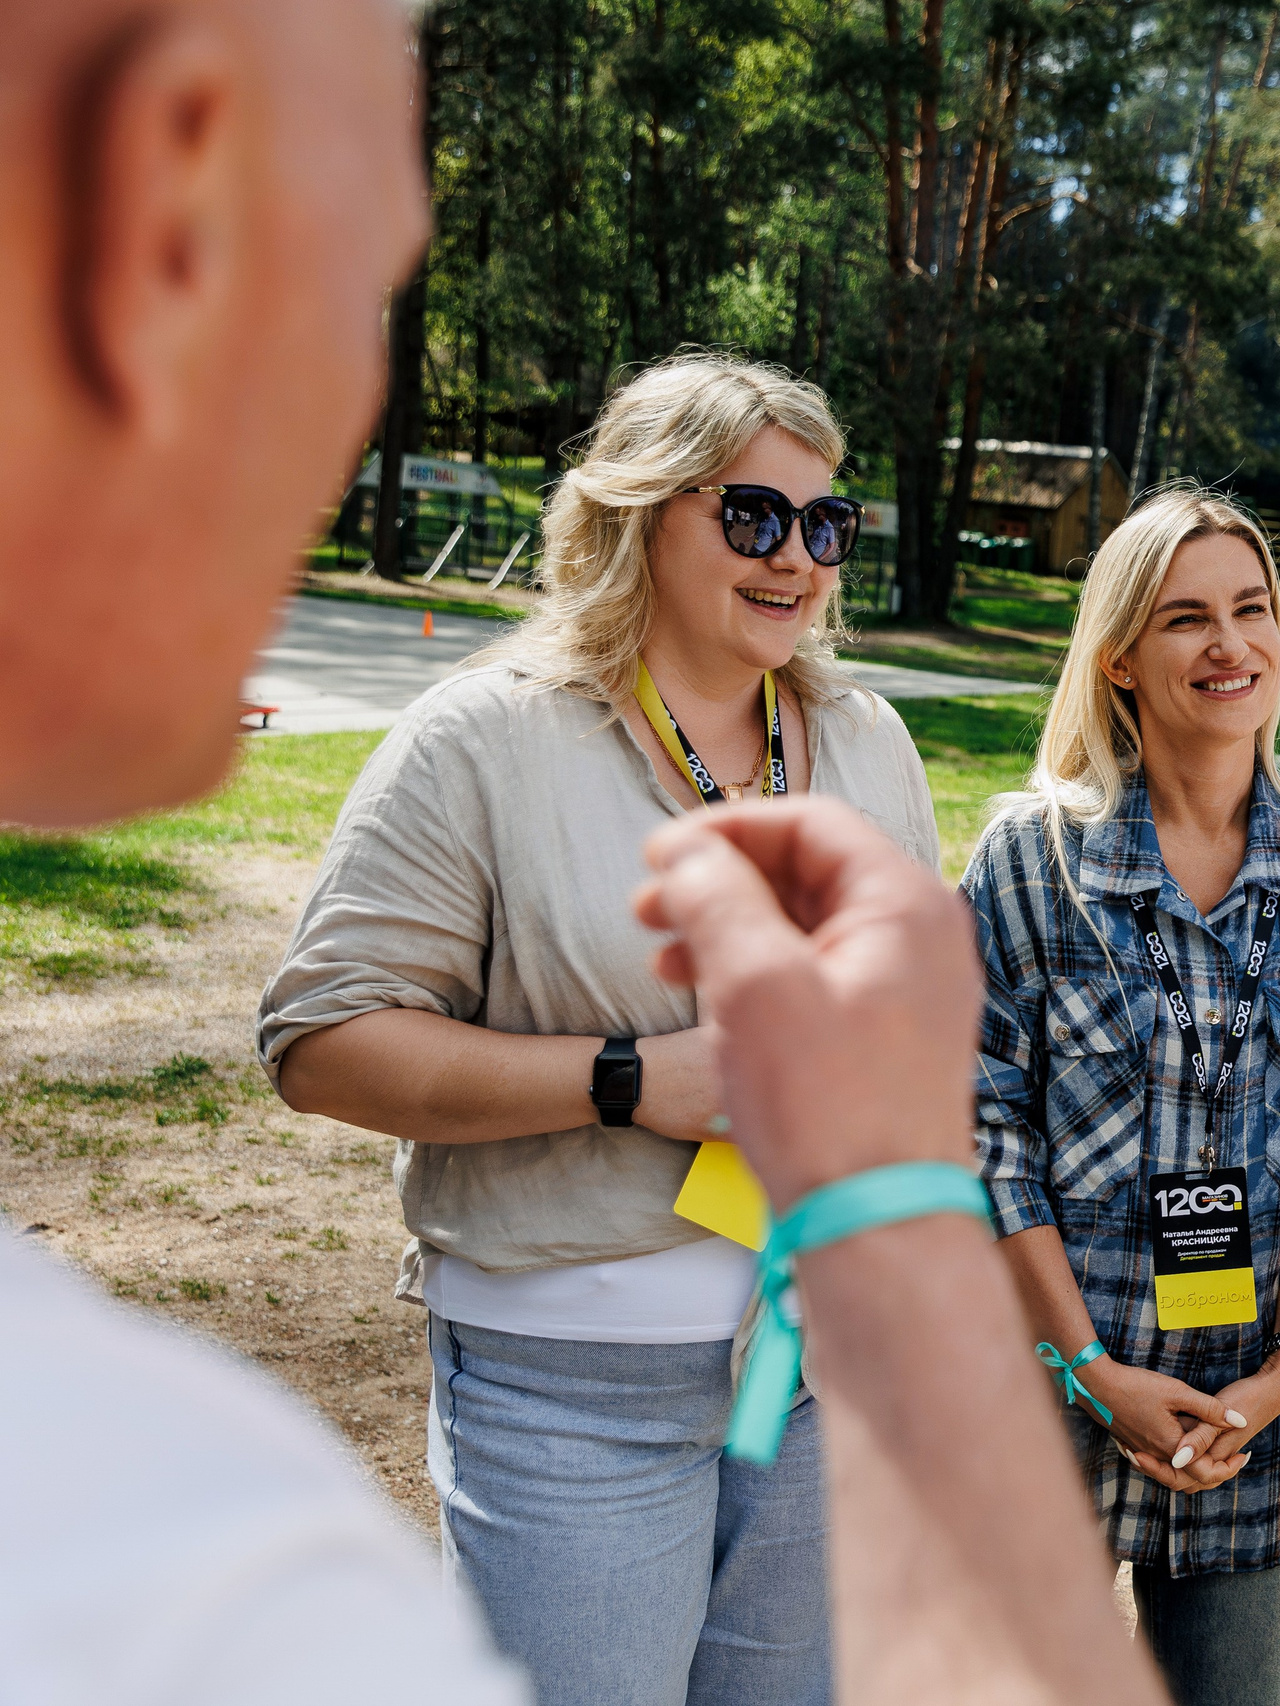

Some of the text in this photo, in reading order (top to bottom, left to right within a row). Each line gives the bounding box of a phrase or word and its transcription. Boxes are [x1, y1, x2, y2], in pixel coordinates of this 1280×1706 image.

[1146, 932, 1169, 970] 1200
[1247, 940, 1267, 977] 1200
[1169, 991, 1193, 1030] 1200
[1232, 1000, 1251, 1038] 1200
[1154, 1184, 1243, 1218] 1200
[1162, 1226, 1239, 1239] Наталья Андреевна
[1171, 1234, 1231, 1247] КРАСНИЦКАЯ
[1159, 1290, 1254, 1310] Доброном
